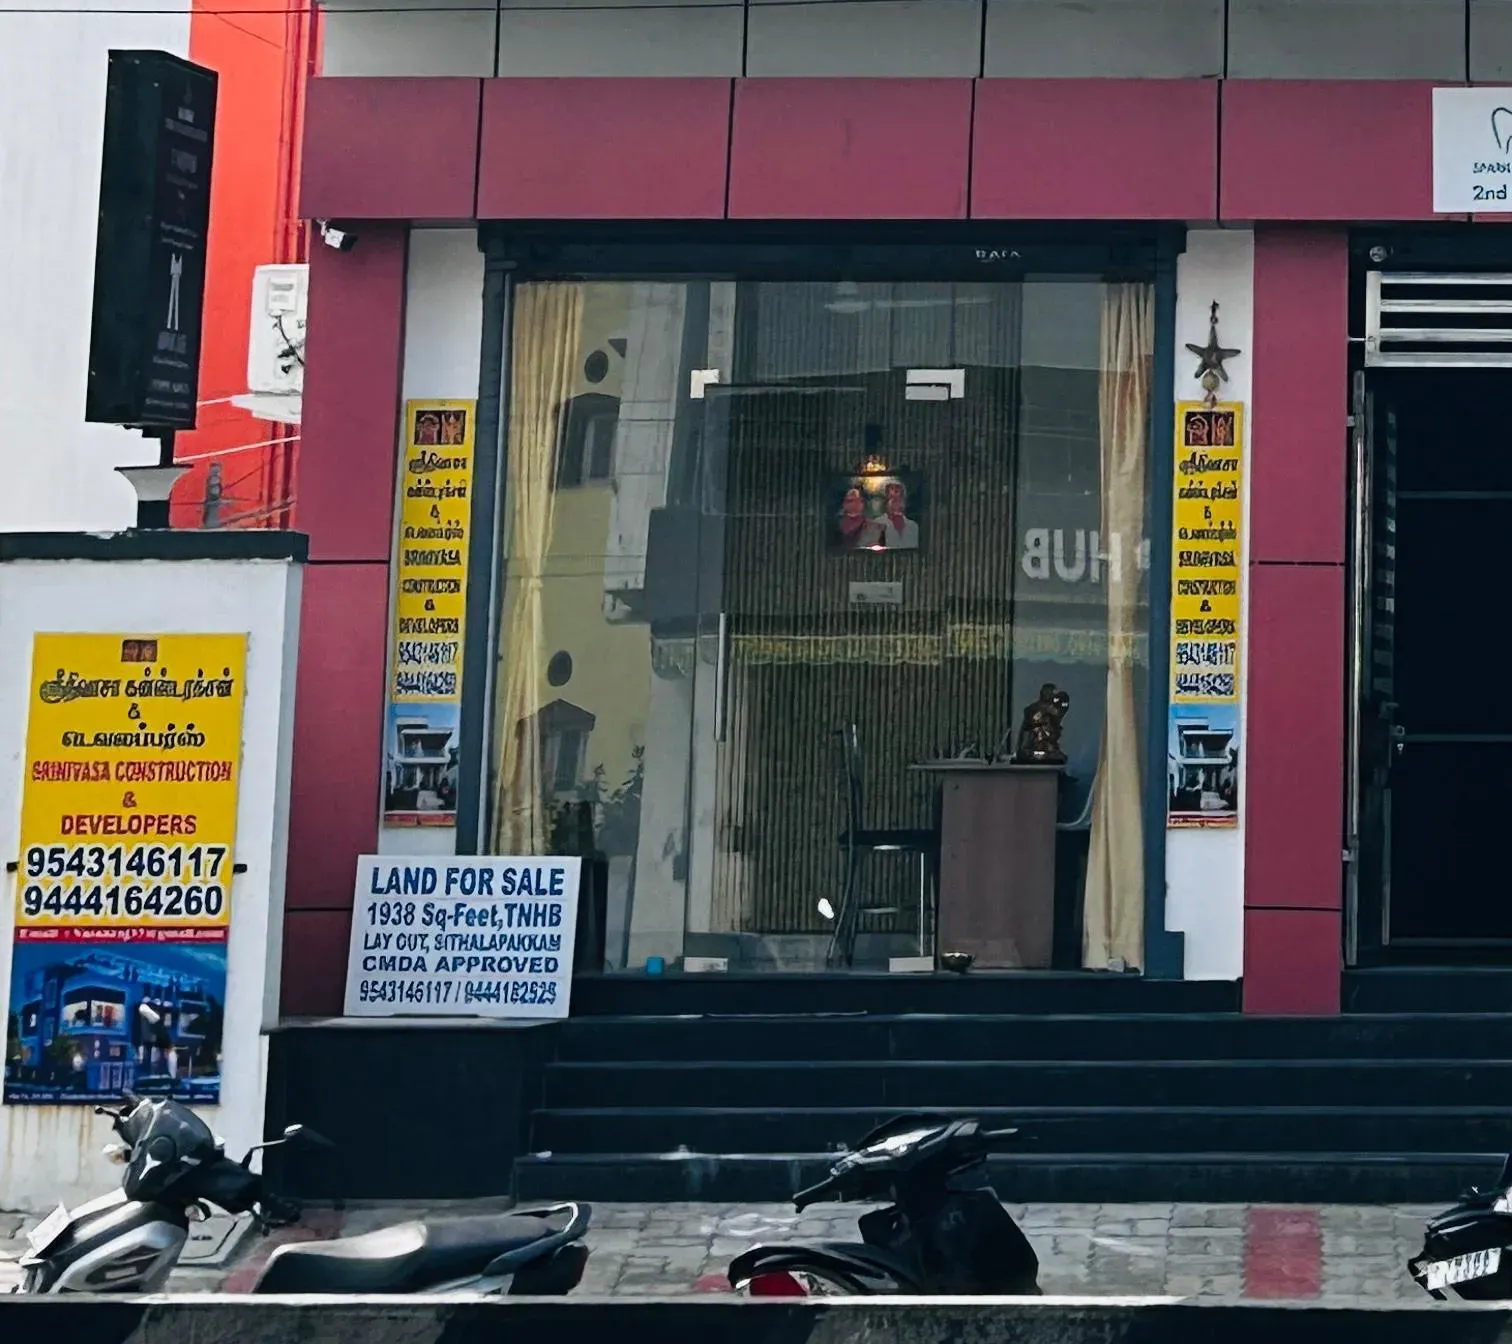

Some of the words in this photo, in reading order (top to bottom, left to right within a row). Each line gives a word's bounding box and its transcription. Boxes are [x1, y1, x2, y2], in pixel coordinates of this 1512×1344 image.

[1472, 184, 1507, 201] 2nd
[115, 761, 232, 781] CONSTRUCTION
[122, 791, 137, 808] &
[61, 815, 197, 835] DEVELOPERS
[27, 847, 226, 878] 9543146117
[371, 867, 437, 895] LAND
[445, 868, 494, 896] FOR
[501, 868, 565, 896] SALE
[24, 886, 223, 915] 9444164260
[367, 902, 415, 925] 1938
[364, 933, 391, 950] LAY
[397, 934, 430, 953] OUT,
[362, 956, 427, 972] CMDA
[435, 956, 559, 973] APPROVED
